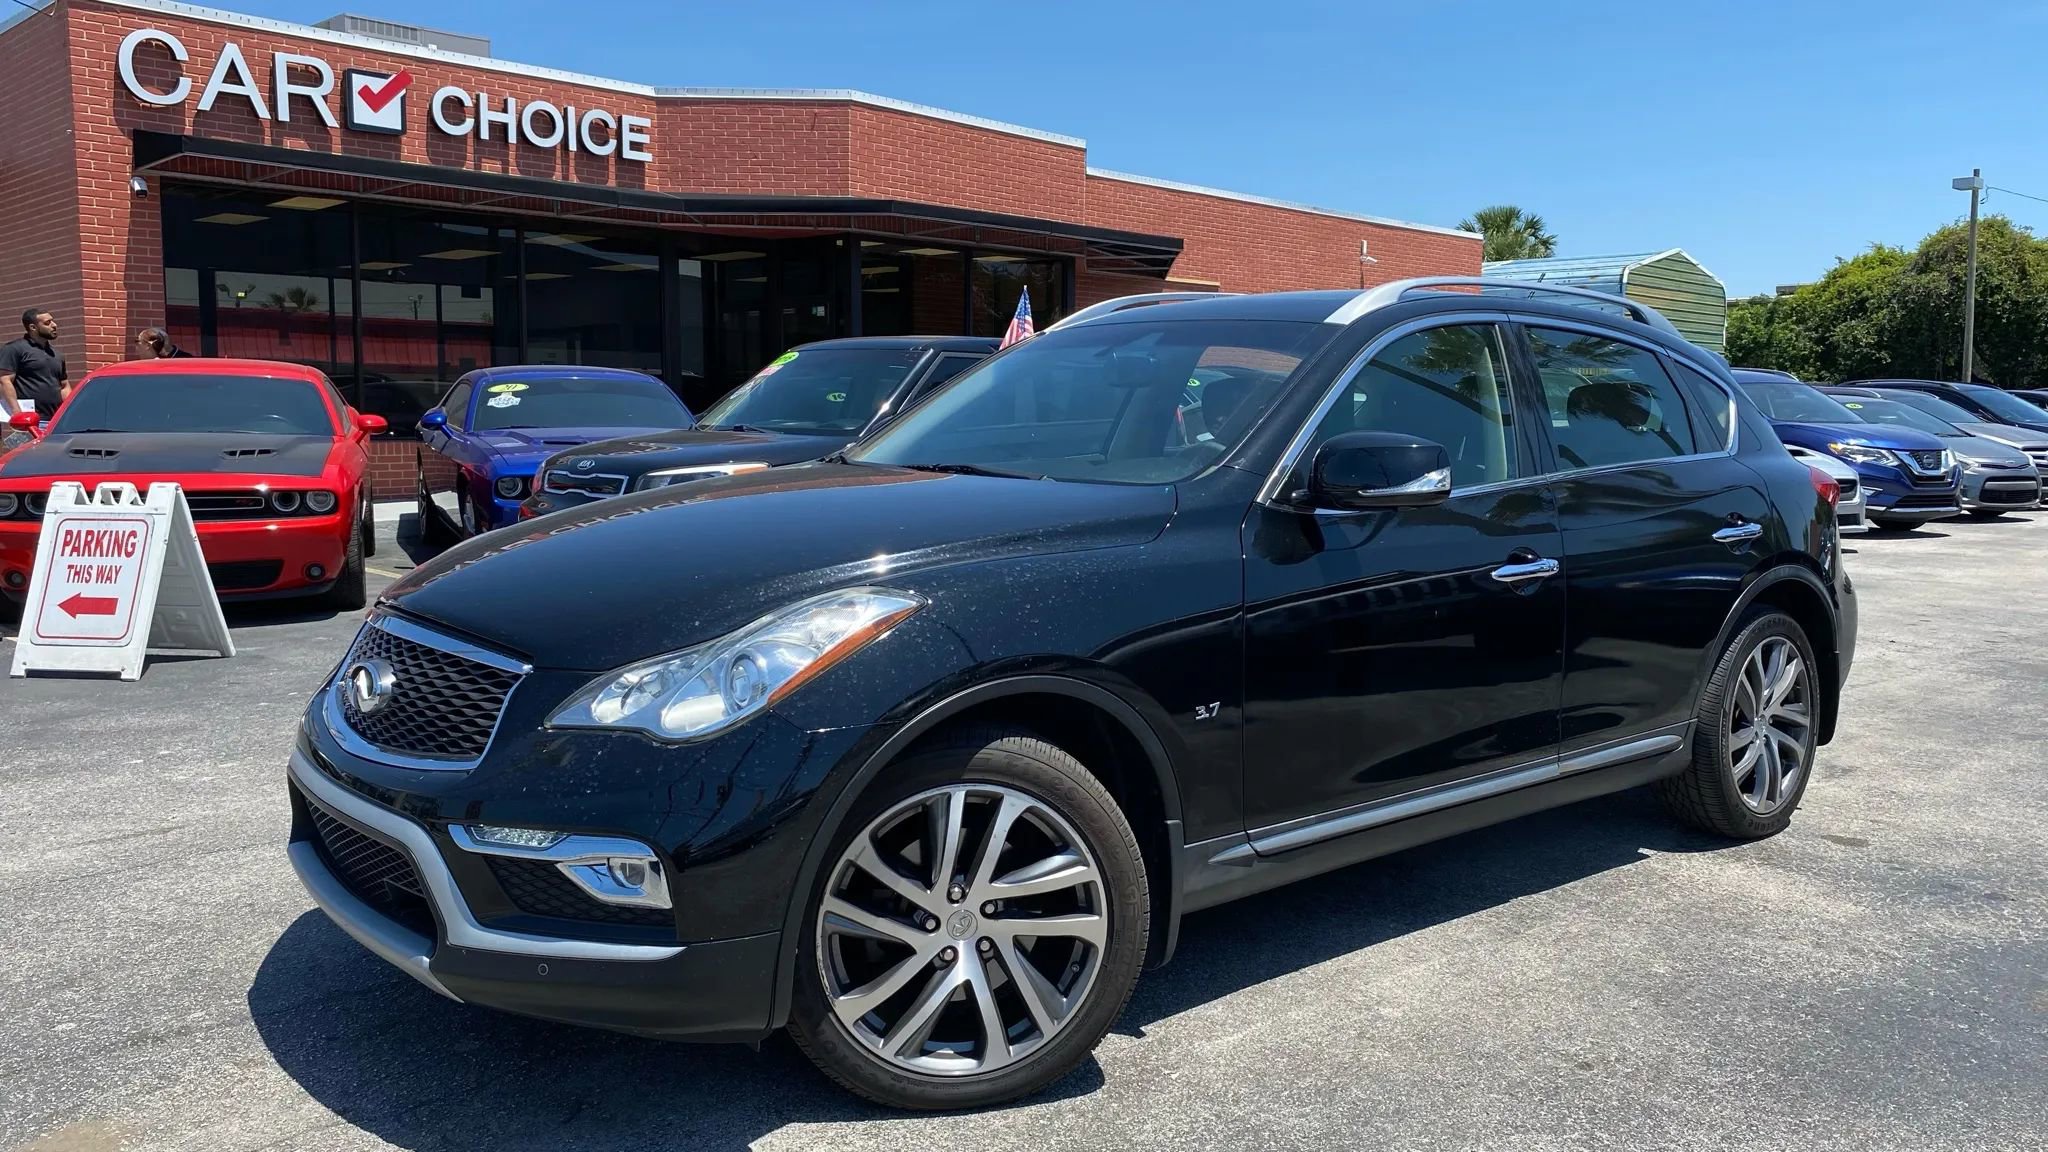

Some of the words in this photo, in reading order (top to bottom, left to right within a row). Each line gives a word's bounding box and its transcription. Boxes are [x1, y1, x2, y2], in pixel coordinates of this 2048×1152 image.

[118, 28, 341, 128] CAR
[432, 86, 653, 163] CHOICE
[60, 529, 138, 559] PARKING
[66, 564, 93, 584] THIS
[95, 565, 122, 585] WAY
